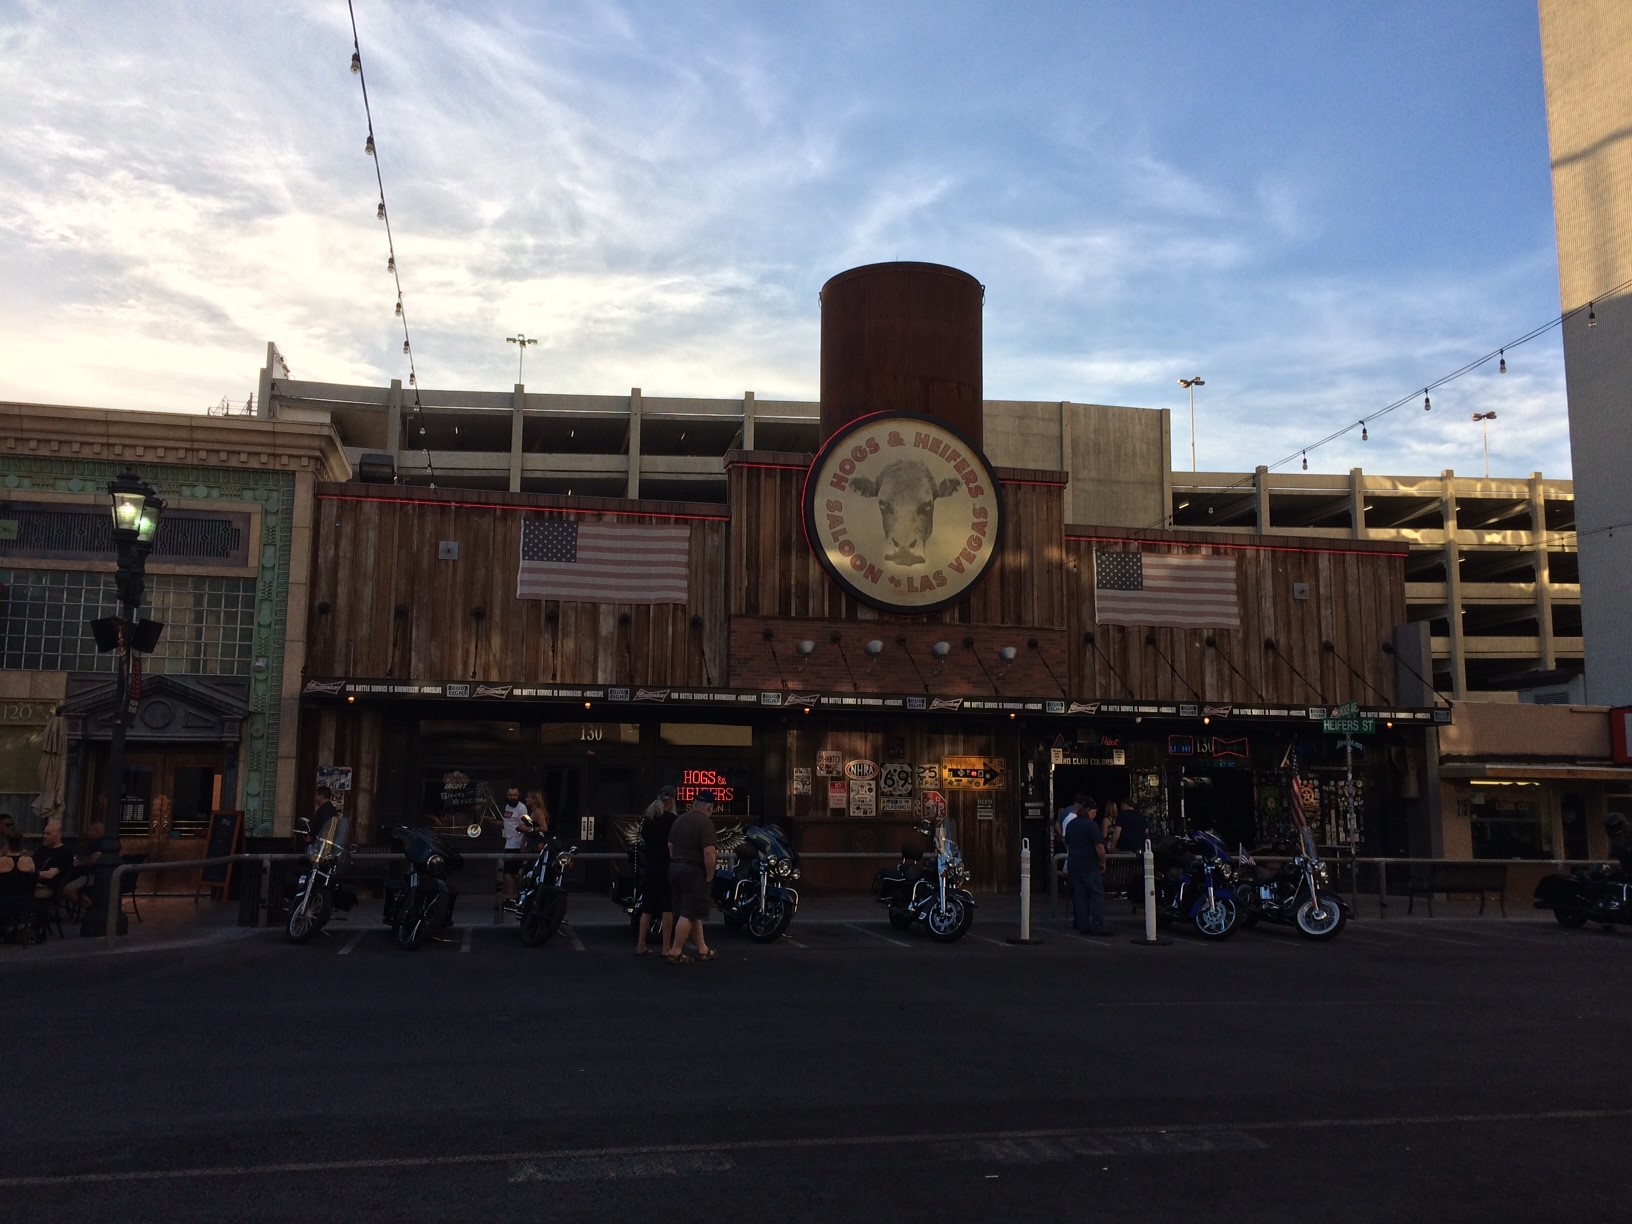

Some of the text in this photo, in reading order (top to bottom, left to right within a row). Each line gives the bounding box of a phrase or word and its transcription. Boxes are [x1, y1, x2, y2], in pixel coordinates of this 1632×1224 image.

[830, 431, 985, 499] HOGS & HEIFERS
[826, 499, 883, 584] SALOON
[907, 506, 988, 593] LAS VEGAS
[3, 704, 32, 720] 120
[579, 725, 603, 741] 130
[1323, 719, 1374, 731] HEIFERS ST
[849, 763, 876, 777] NHRA
[1090, 758, 1114, 766] COLORS
[683, 770, 727, 785] HOGS &
[884, 770, 910, 788] 69
[917, 766, 938, 779] 25
